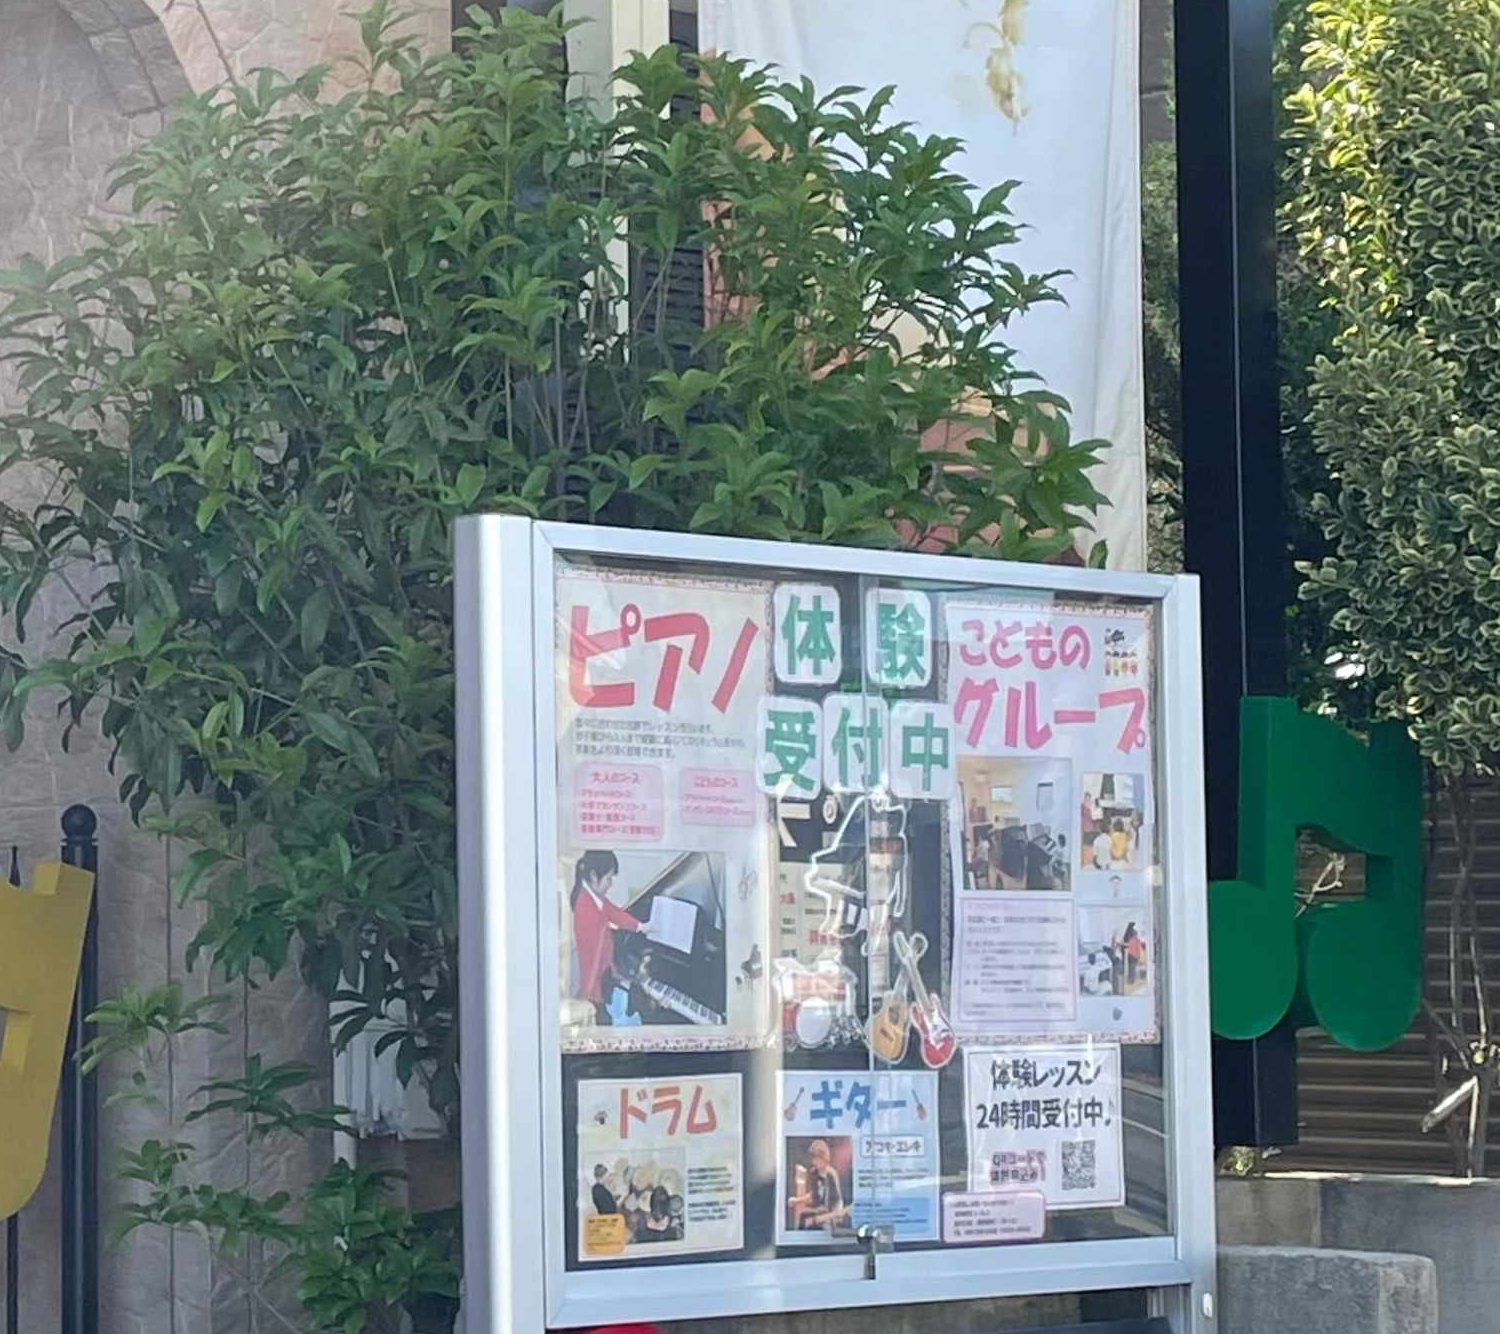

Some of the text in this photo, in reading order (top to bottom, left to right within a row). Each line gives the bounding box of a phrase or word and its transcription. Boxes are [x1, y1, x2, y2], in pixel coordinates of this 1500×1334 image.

[569, 603, 760, 715] ピアノ
[959, 618, 1091, 671] こどもの
[953, 676, 1146, 755] グループ
[763, 705, 949, 792] 受付中
[990, 1058, 1103, 1090] 体験レッスン
[619, 1084, 718, 1140] ドラム
[809, 1079, 907, 1129] ギター
